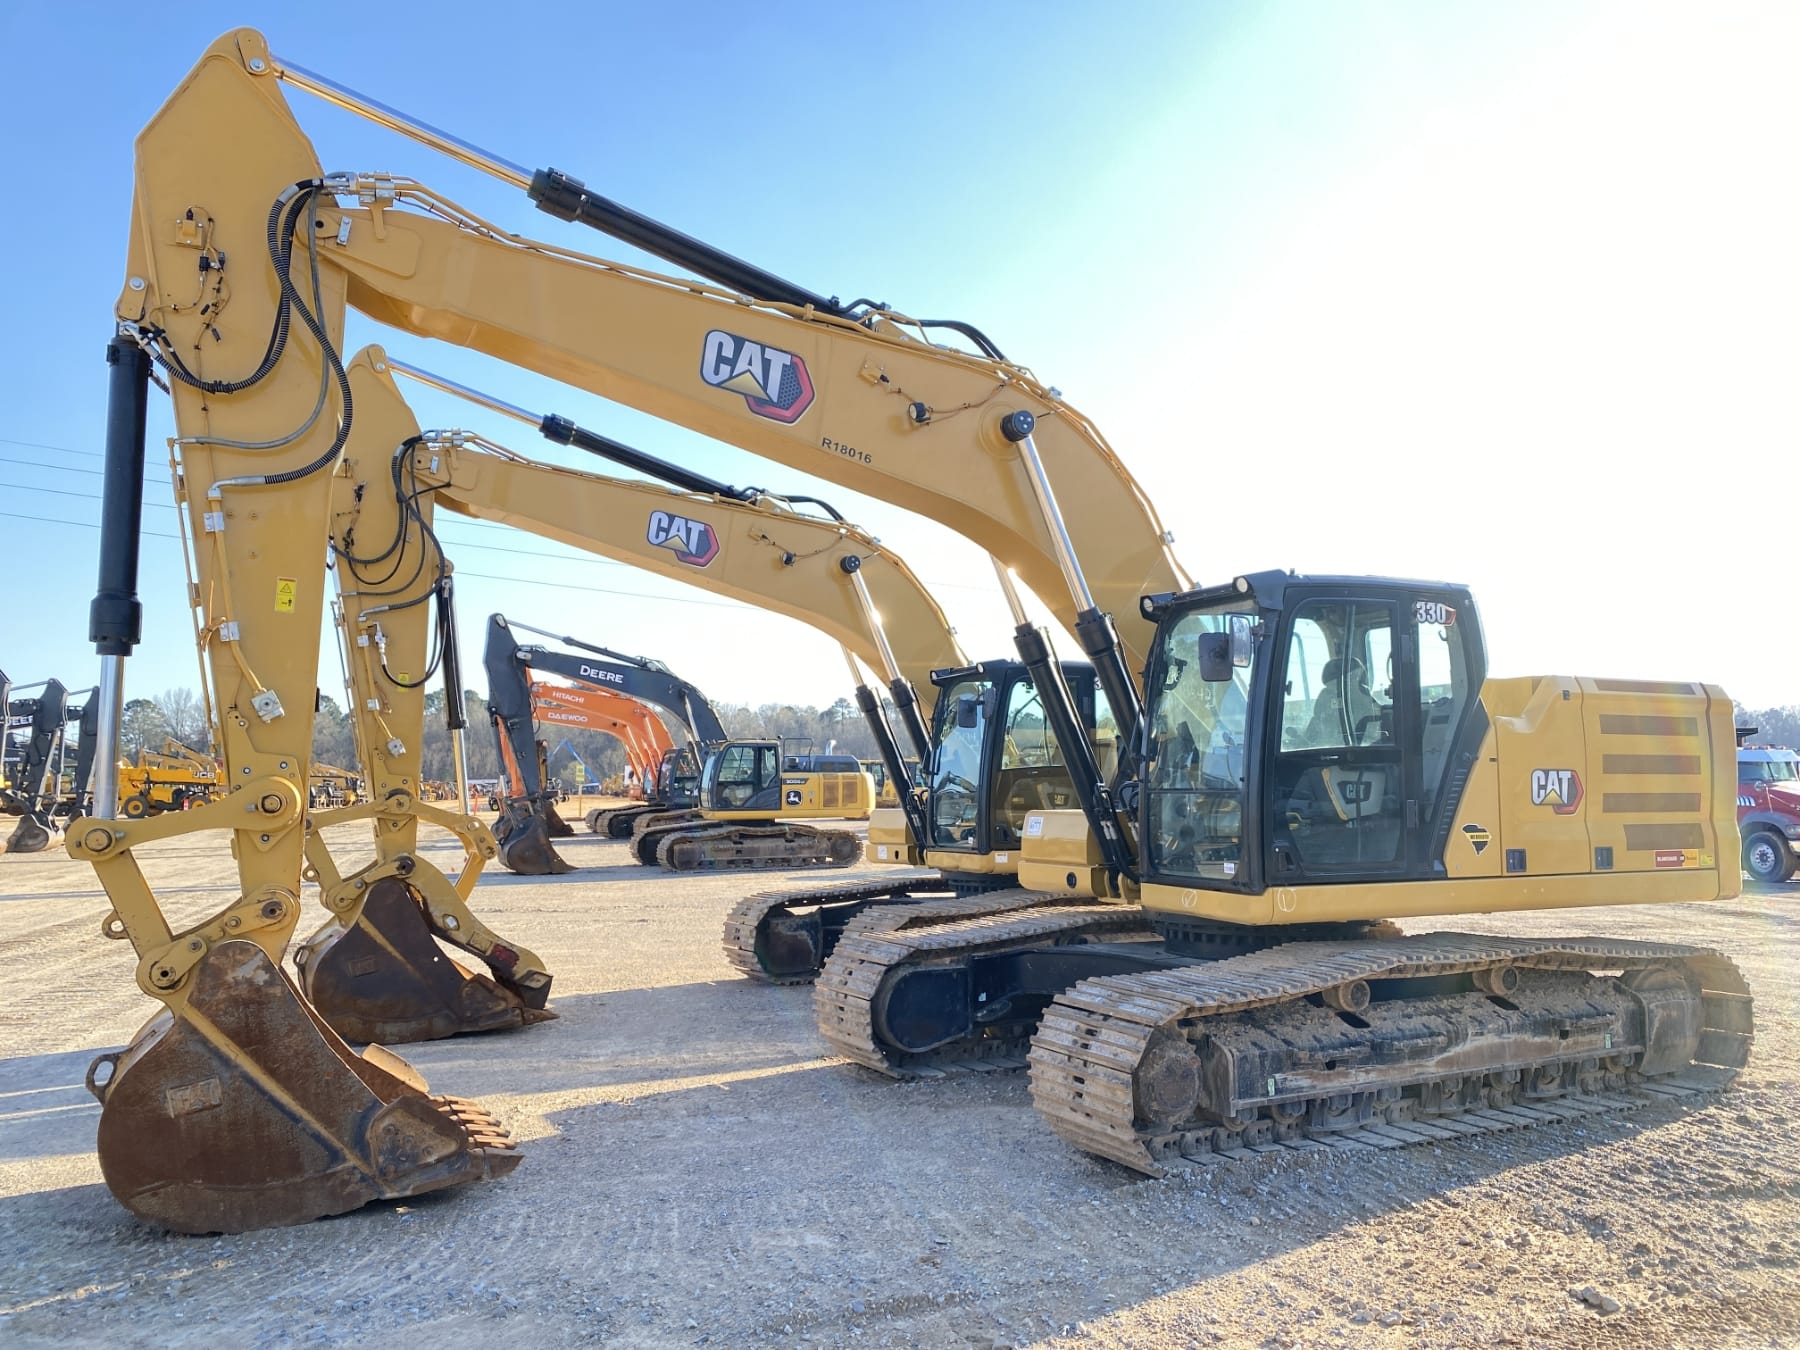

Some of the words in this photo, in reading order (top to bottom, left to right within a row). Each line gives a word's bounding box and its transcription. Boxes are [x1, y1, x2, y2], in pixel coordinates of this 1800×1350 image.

[701, 330, 792, 404] CAT
[821, 437, 873, 464] R18016
[647, 510, 705, 555] CAT
[1415, 601, 1447, 622] 330
[579, 664, 624, 684] DEERE
[552, 690, 585, 705] HITACHI
[547, 711, 589, 723] DAEWOO
[193, 770, 215, 779] JCB
[1531, 769, 1572, 805] CAT
